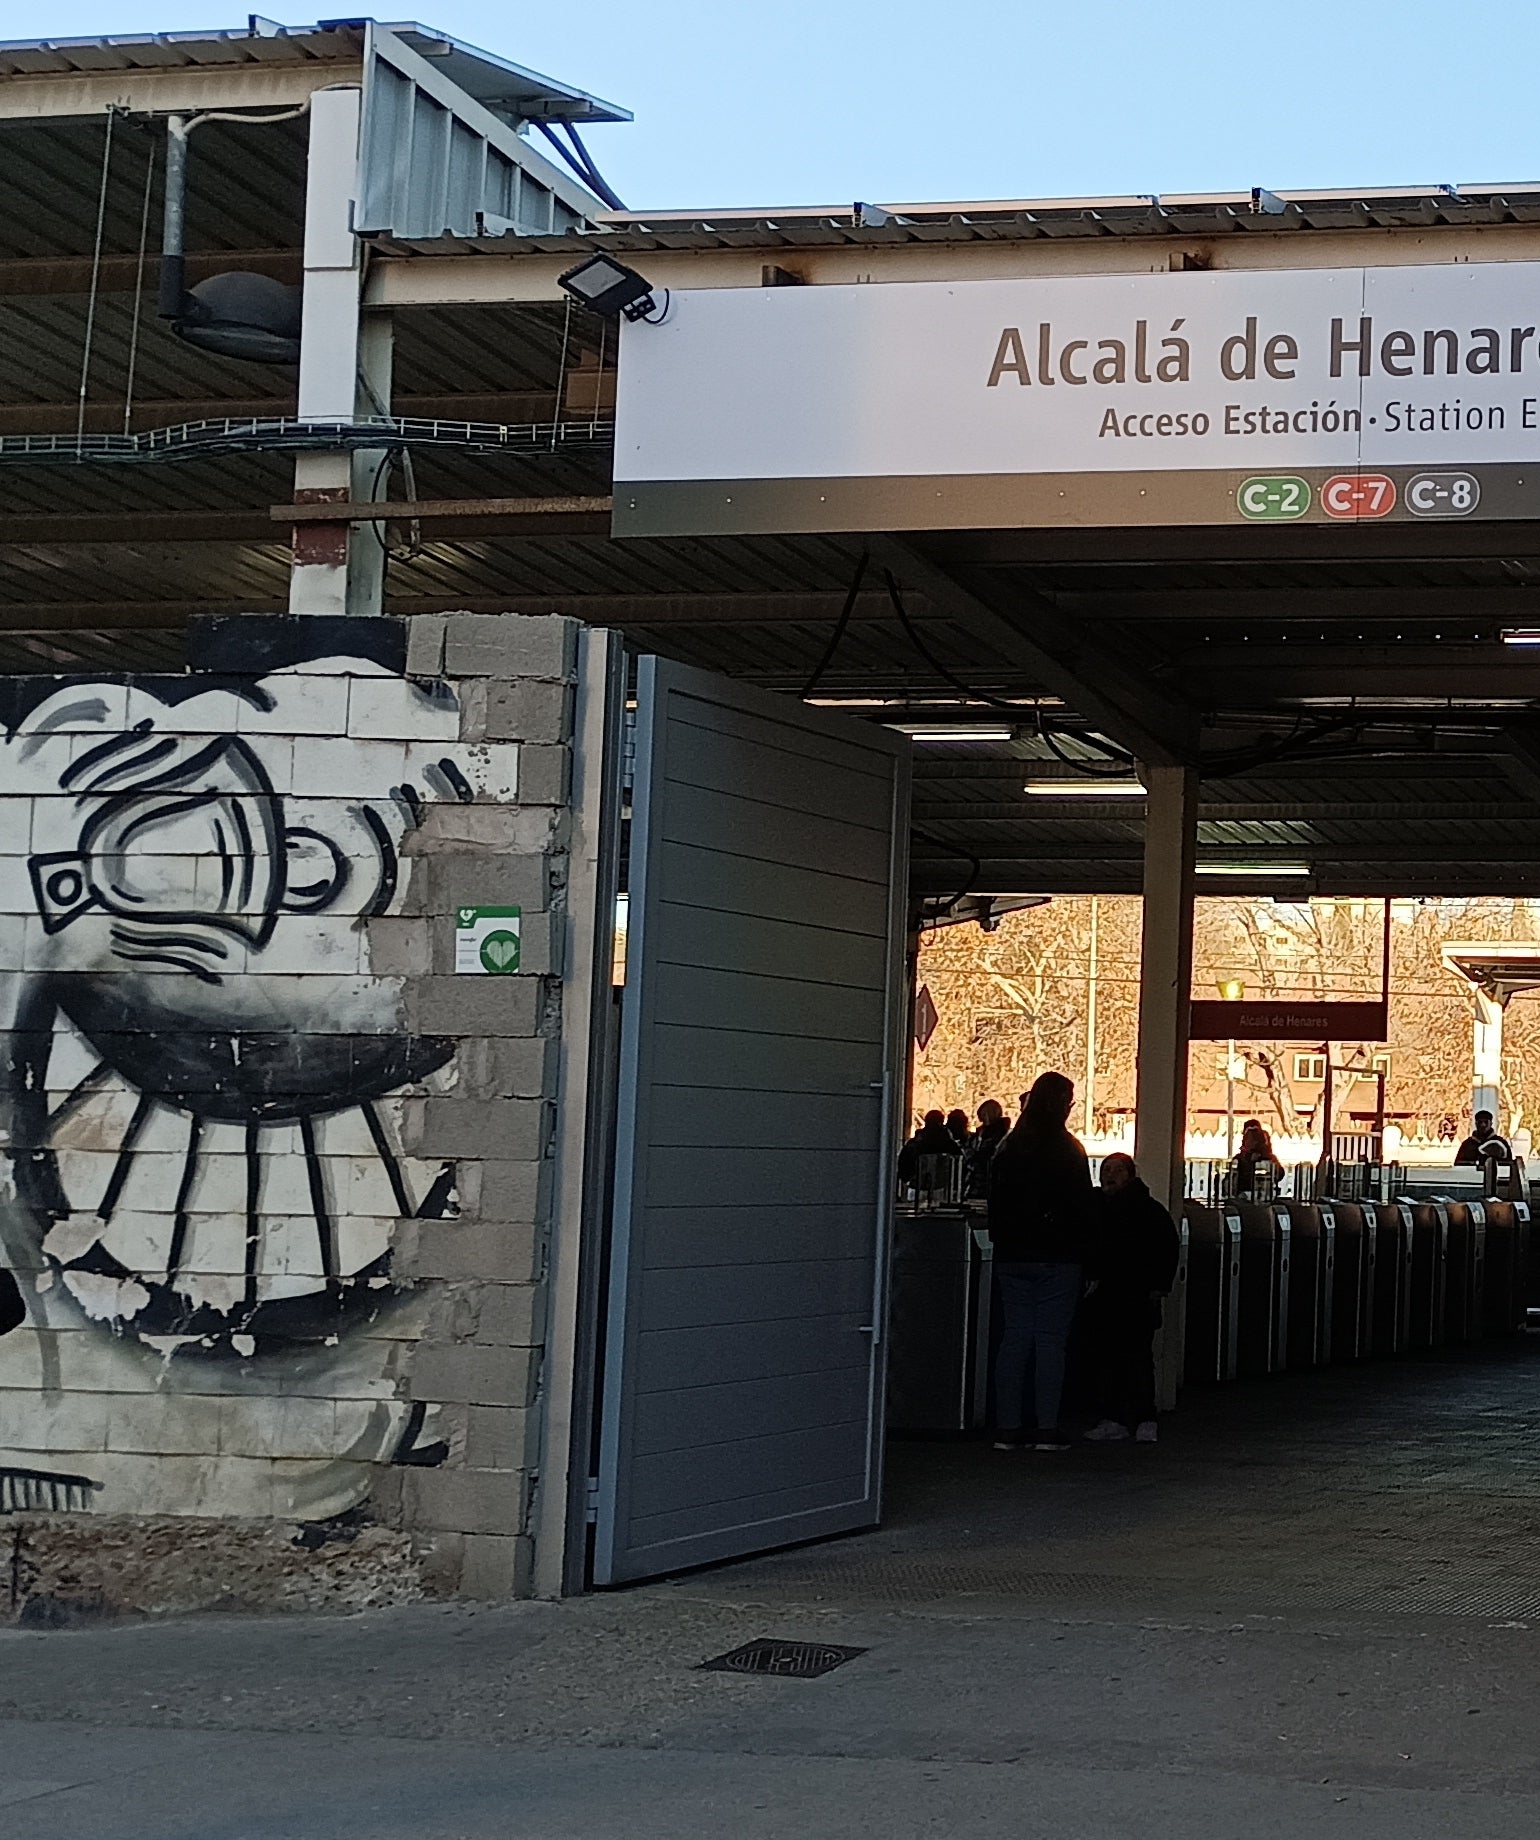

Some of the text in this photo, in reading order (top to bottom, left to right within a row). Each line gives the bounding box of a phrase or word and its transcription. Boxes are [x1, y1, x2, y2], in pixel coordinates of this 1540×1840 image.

[986, 318, 1190, 387] Alcalá
[1220, 316, 1299, 381] de
[1098, 408, 1210, 438] Acceso
[1224, 400, 1362, 435] Estación
[1384, 401, 1505, 433] Station
[1243, 480, 1471, 513] C-2 C-7 C-8
[1271, 1015, 1285, 1027] de
[1286, 1015, 1328, 1028] Henares
